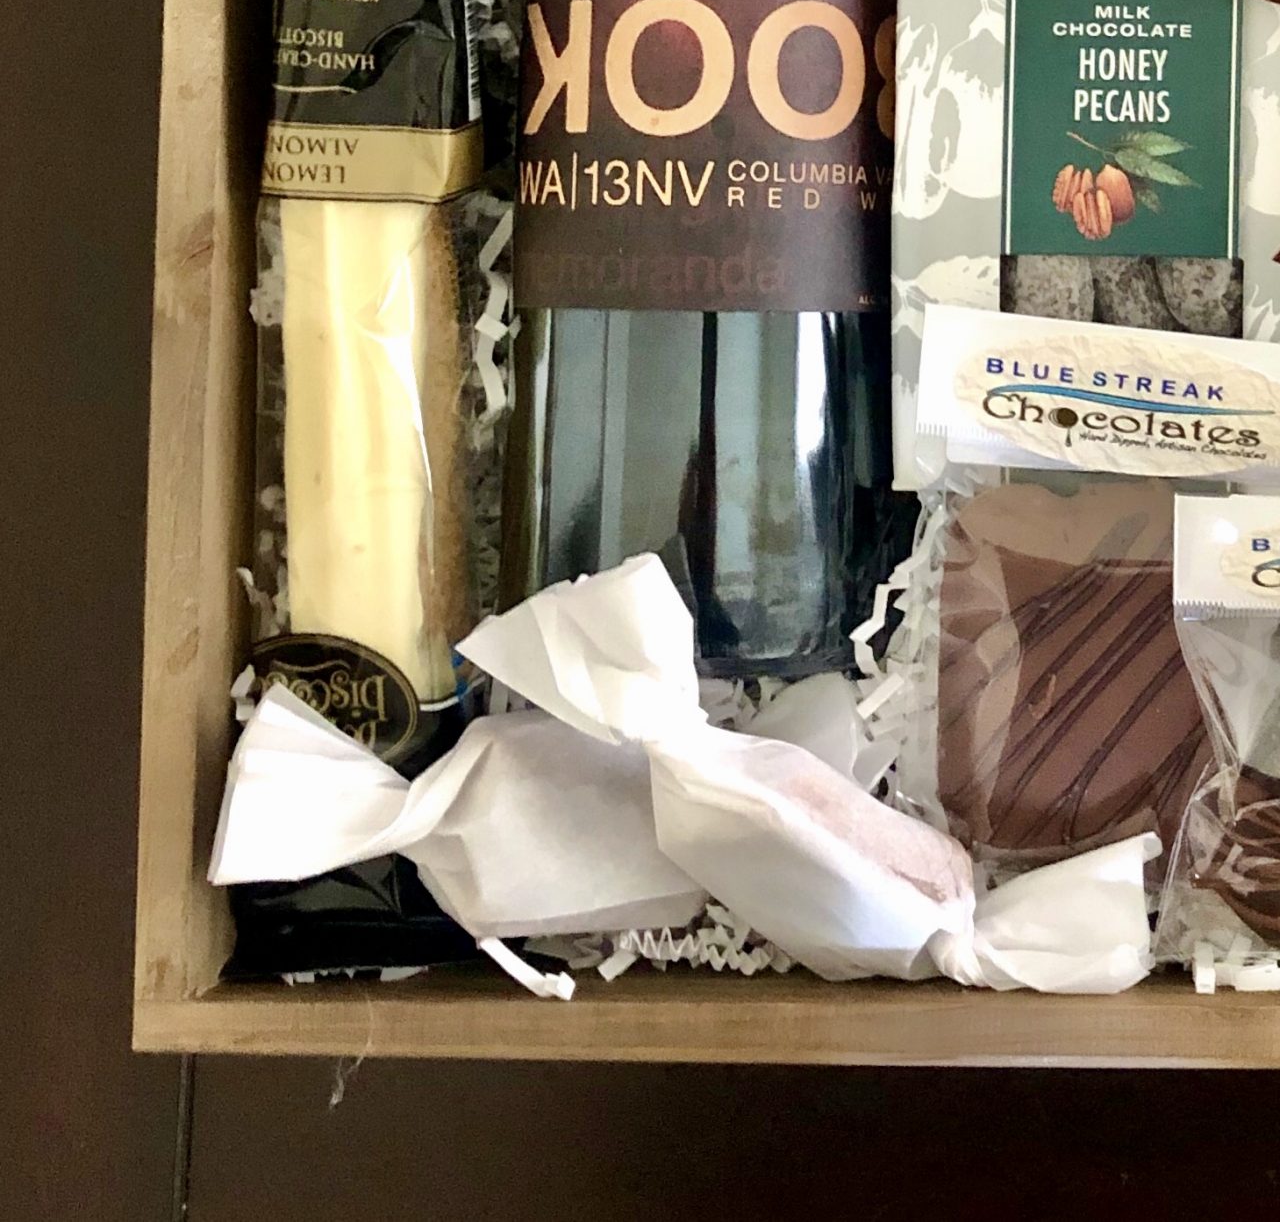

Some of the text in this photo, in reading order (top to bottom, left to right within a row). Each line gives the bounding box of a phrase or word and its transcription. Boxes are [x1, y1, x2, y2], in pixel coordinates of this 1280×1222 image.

[1095, 5, 1150, 19] MILK
[1052, 22, 1193, 38] CHOCOLATE
[1079, 48, 1168, 81] HONEY
[1073, 89, 1170, 123] PECANS
[727, 159, 868, 186] COLUMBIA
[986, 358, 1224, 401] BLUE STREAK
[982, 393, 1260, 447] Chocolates
